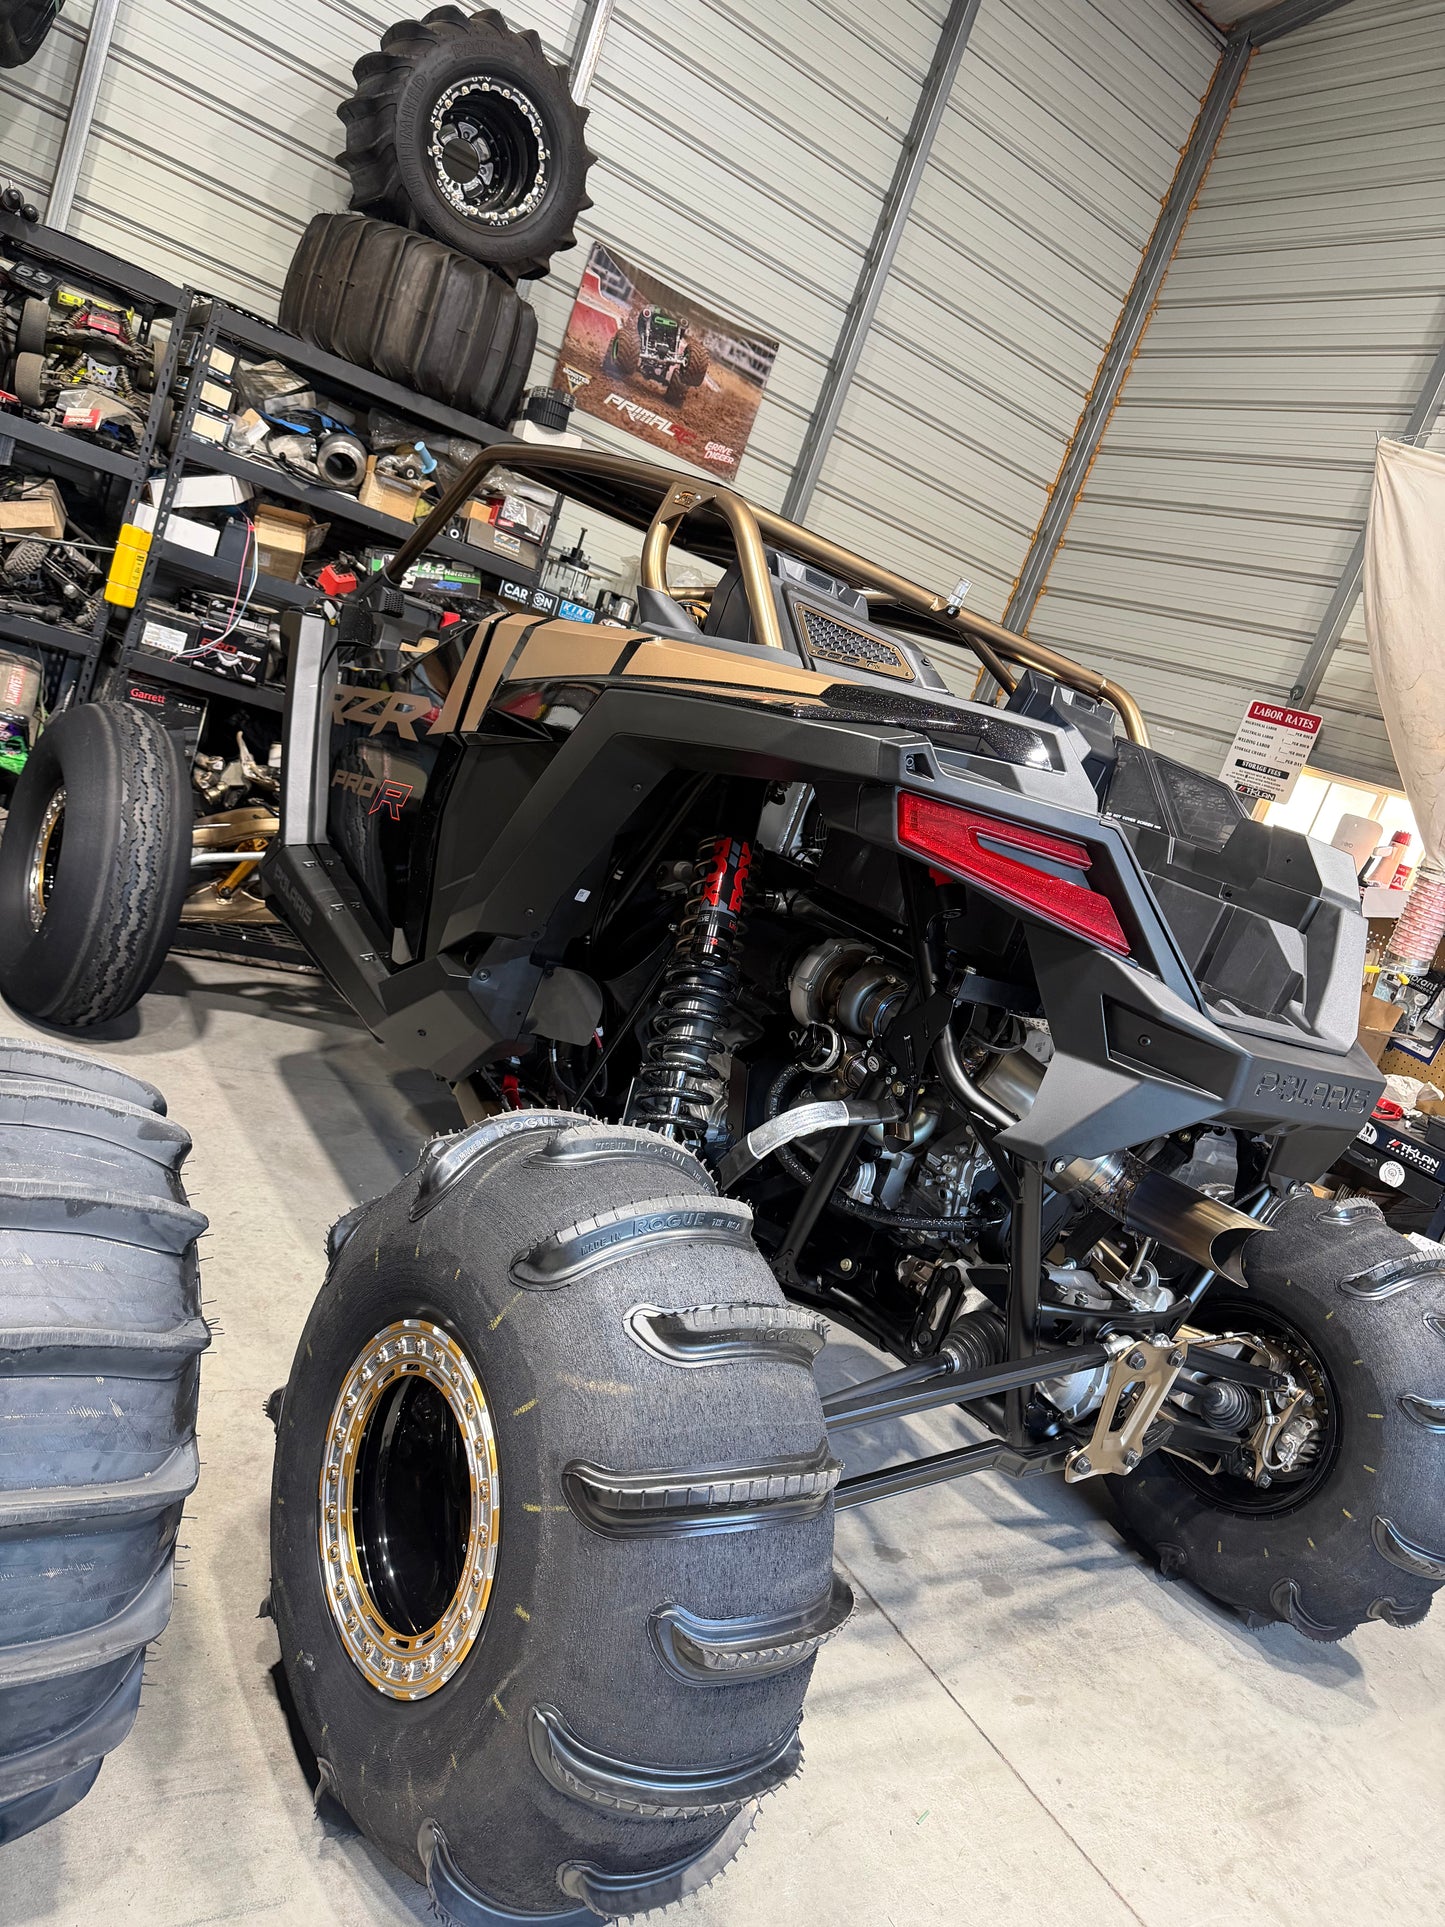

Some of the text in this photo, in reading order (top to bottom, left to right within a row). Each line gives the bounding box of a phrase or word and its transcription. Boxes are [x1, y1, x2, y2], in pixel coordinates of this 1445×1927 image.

[430, 88, 453, 124] KEIZER
[15, 265, 53, 284] 69
[704, 441, 734, 457] GRAVE
[704, 450, 735, 465] DIGGER
[421, 561, 446, 575] 4.2
[445, 569, 476, 579] Harness
[563, 602, 594, 619] KING
[130, 688, 166, 704] Garrett
[1253, 705, 1315, 730] LABOR RATES
[1242, 760, 1267, 774] STORAGE
[1267, 767, 1281, 777] FEES
[331, 769, 414, 821] PRO R
[1255, 1071, 1371, 1114] POLARIS
[496, 1115, 560, 1138] ROGUE
[634, 1139, 686, 1167] ROGUE
[1400, 1142, 1440, 1169] TKLAN
[581, 1240, 606, 1256] MADE
[610, 1232, 622, 1244] IN
[632, 1212, 706, 1236] ROGUE
